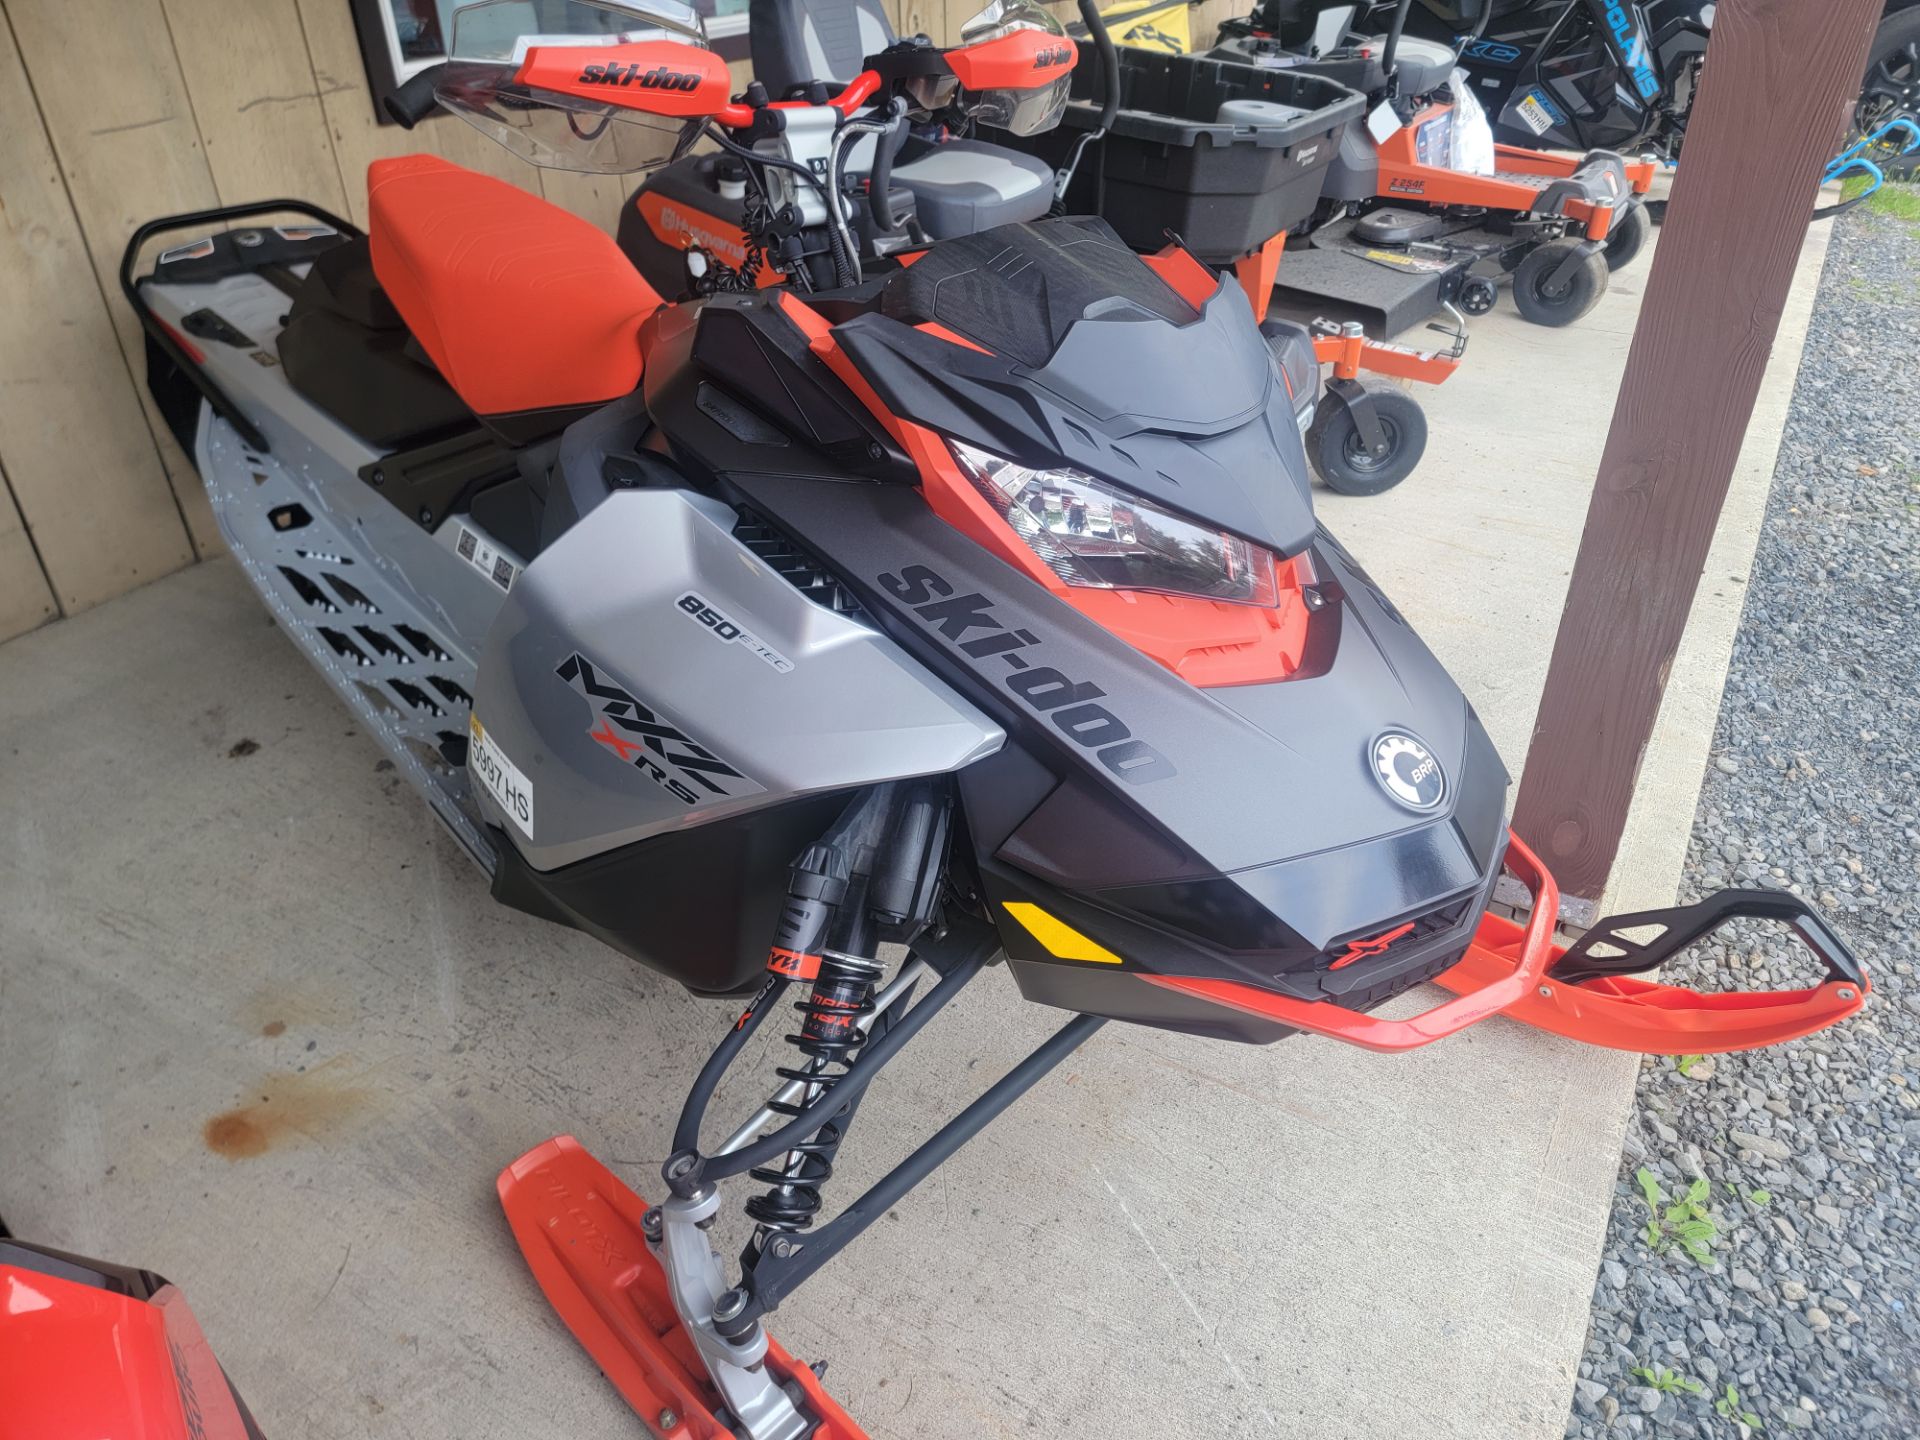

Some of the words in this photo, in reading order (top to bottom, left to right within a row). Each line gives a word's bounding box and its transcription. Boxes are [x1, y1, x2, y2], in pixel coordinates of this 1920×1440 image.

[578, 61, 702, 92] ski-doo
[678, 595, 741, 640] 850
[877, 565, 1177, 786] ski-doo
[473, 735, 502, 790] 5997
[505, 777, 529, 822] HS
[1411, 758, 1433, 784] BRP
